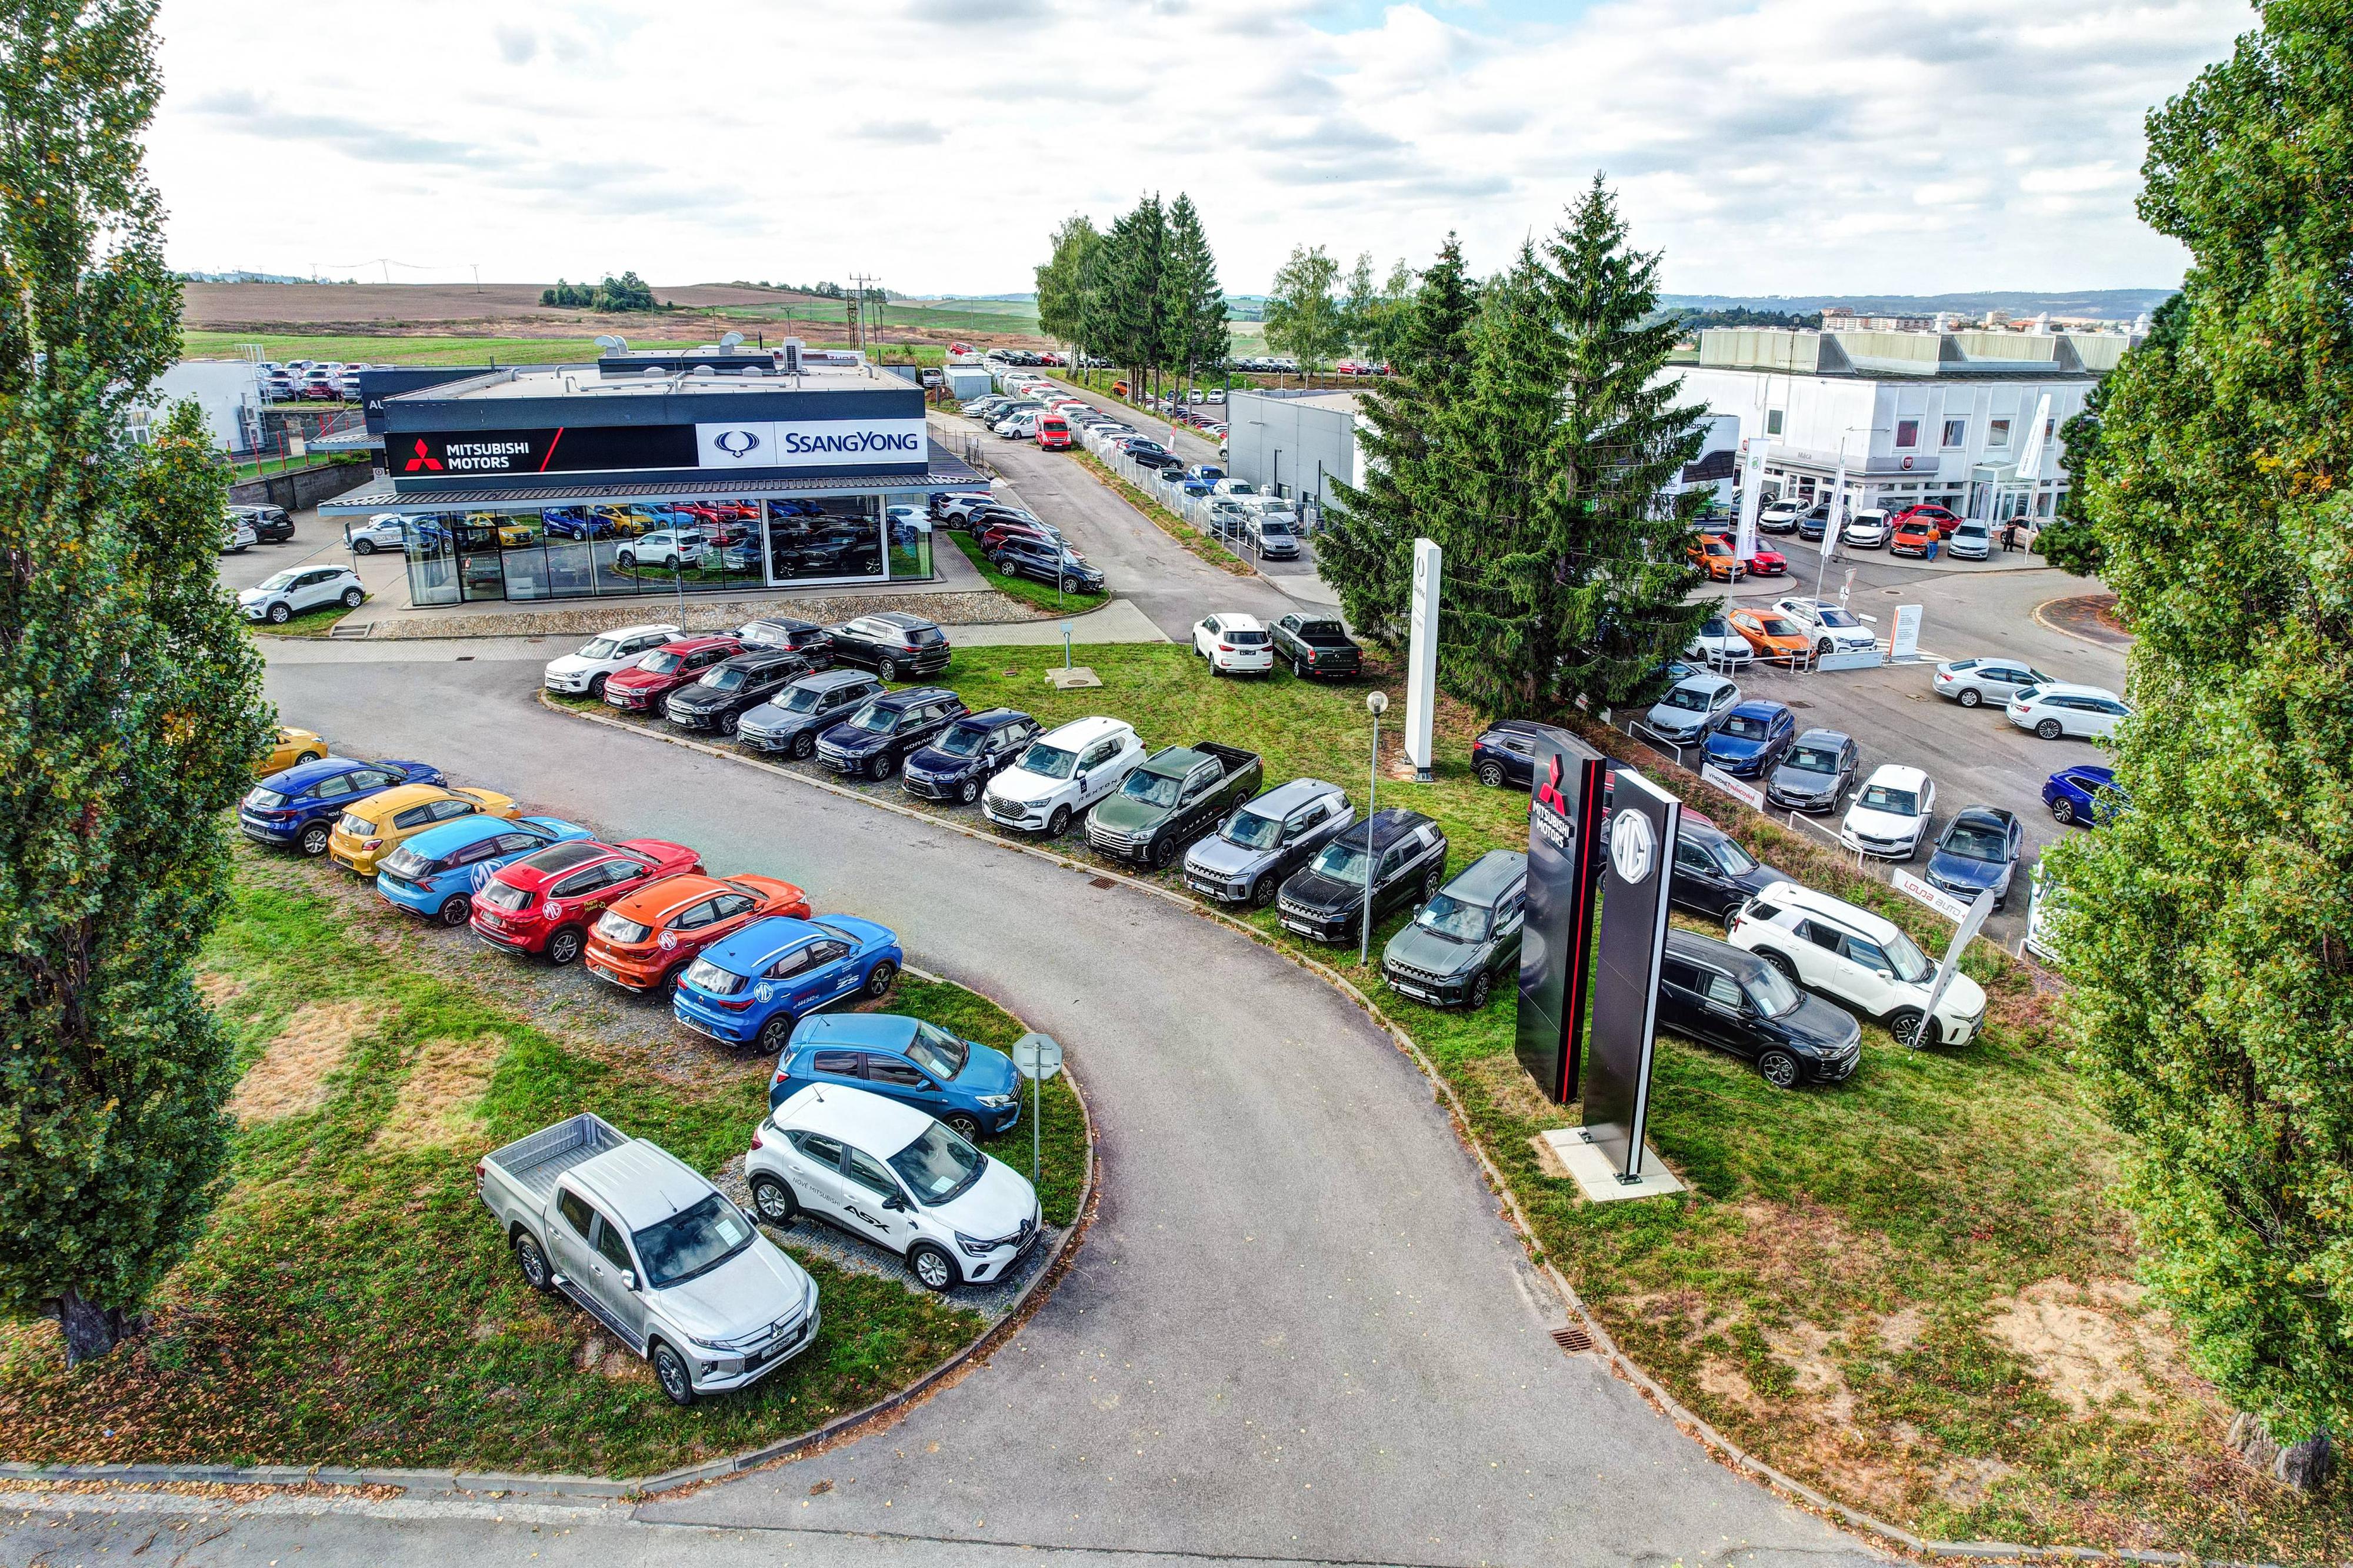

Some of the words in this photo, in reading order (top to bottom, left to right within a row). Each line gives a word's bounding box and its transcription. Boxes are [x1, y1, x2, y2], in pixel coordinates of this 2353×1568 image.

[446, 442, 529, 456] MITSUBISHI
[448, 456, 509, 469] MOTORS
[1078, 779, 1118, 802] REXTON
[1533, 800, 1574, 839] MITSUBISHI
[1537, 818, 1568, 848] MOTORS
[792, 1177, 809, 1188] NOVÉ
[809, 1186, 841, 1207] MITSUBISHI
[843, 1205, 891, 1235] ASX
[771, 1337, 789, 1352] L200
